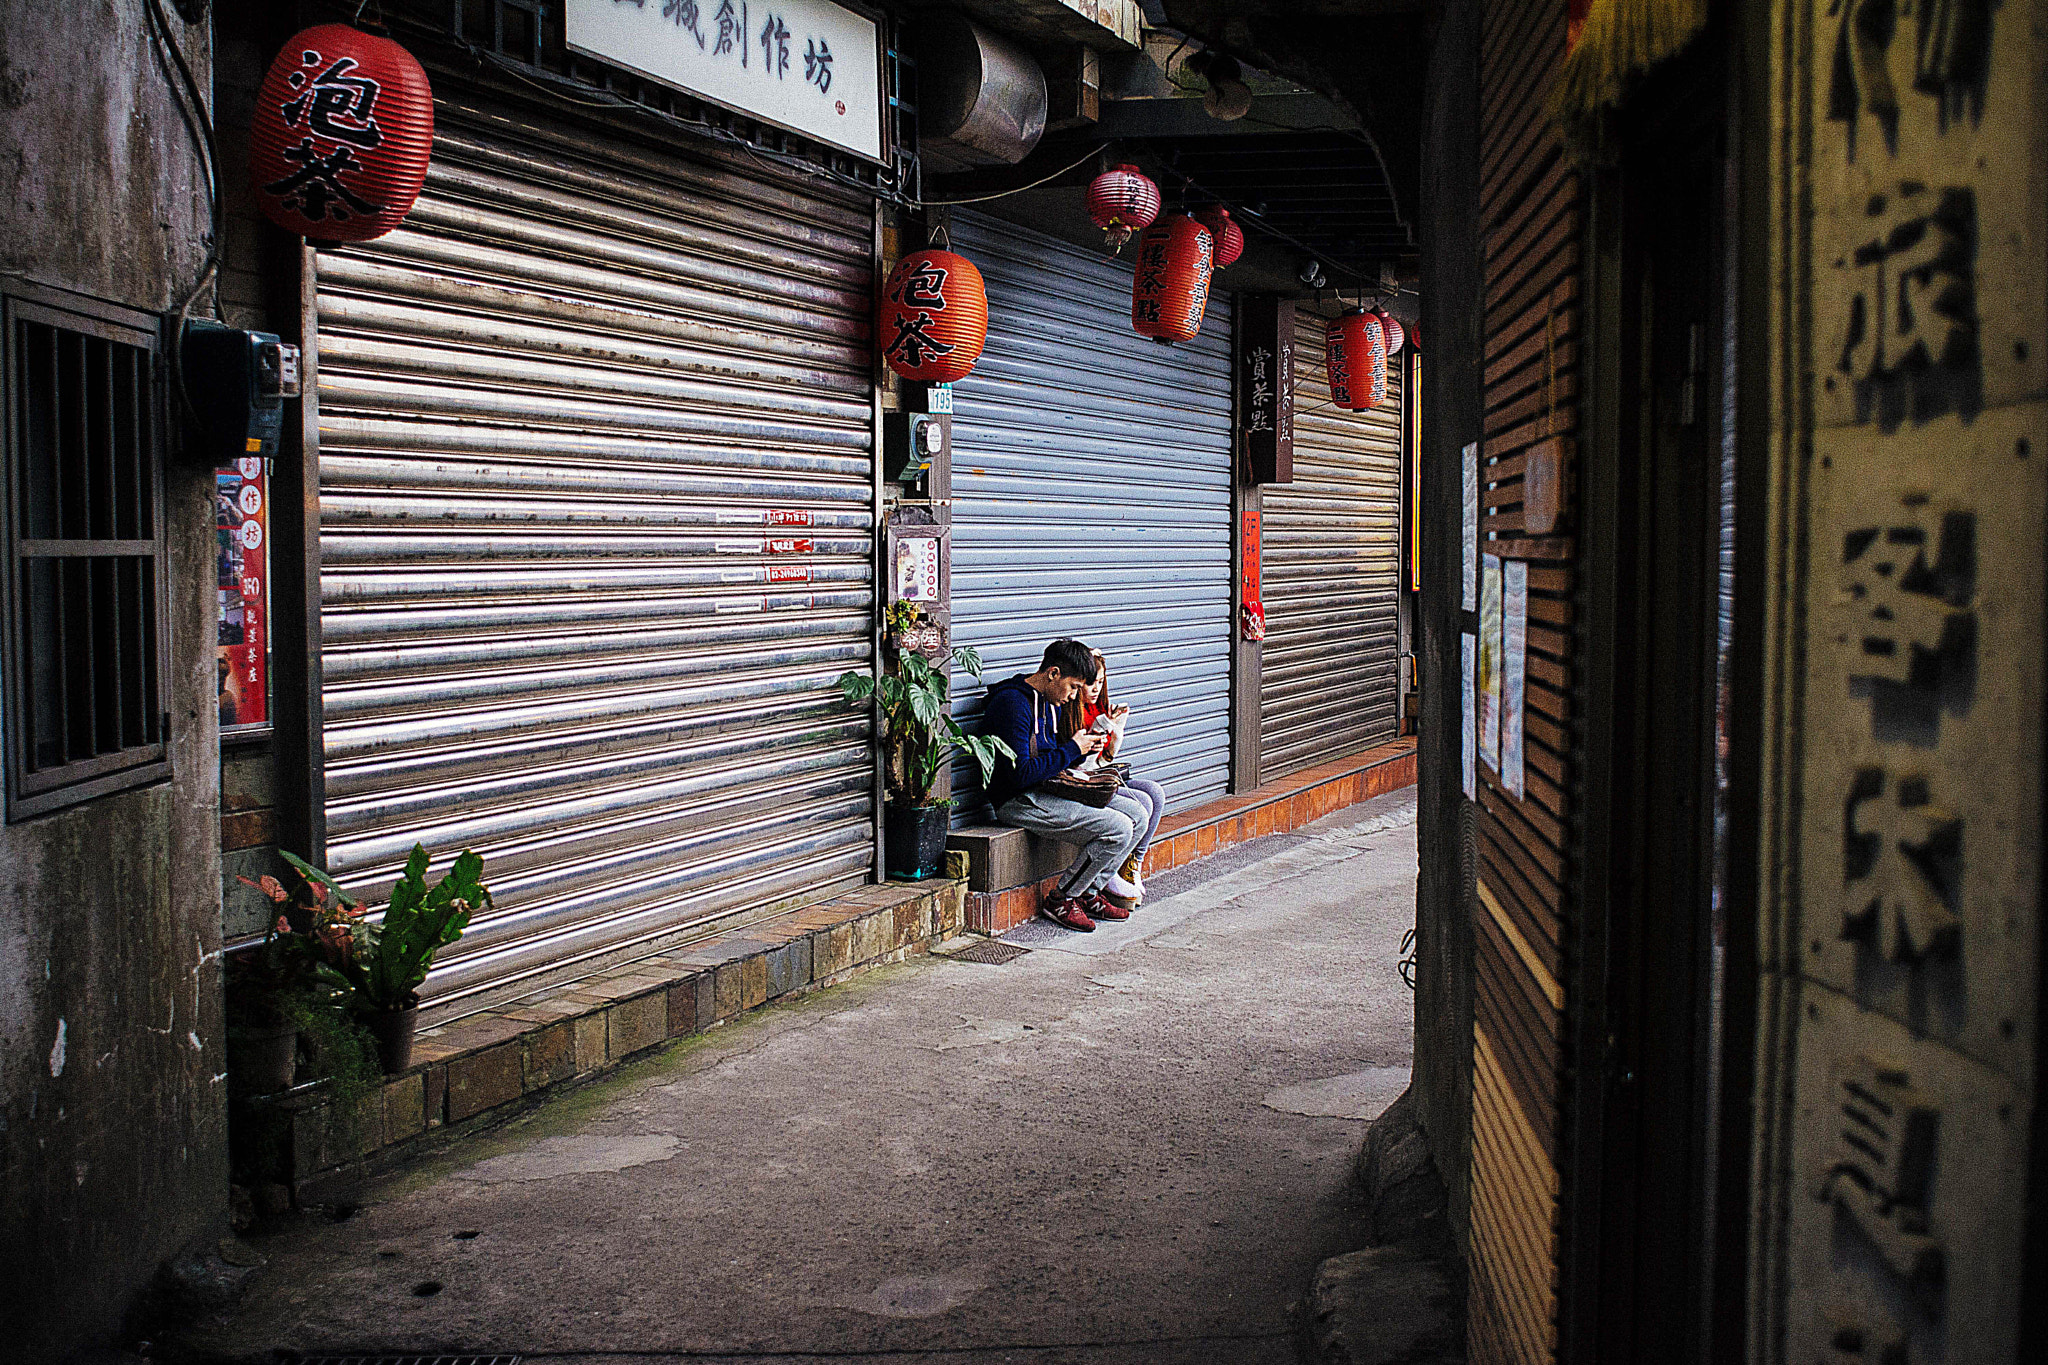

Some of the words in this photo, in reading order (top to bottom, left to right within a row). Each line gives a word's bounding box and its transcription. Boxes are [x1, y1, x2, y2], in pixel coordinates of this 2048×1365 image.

[614, 0, 834, 94] 城創作坊
[264, 48, 389, 222] 泡茶
[883, 260, 956, 370] 泡茶
[934, 392, 951, 409] 195
[1246, 346, 1274, 434] 賞茶點
[1246, 517, 1257, 536] 2F
